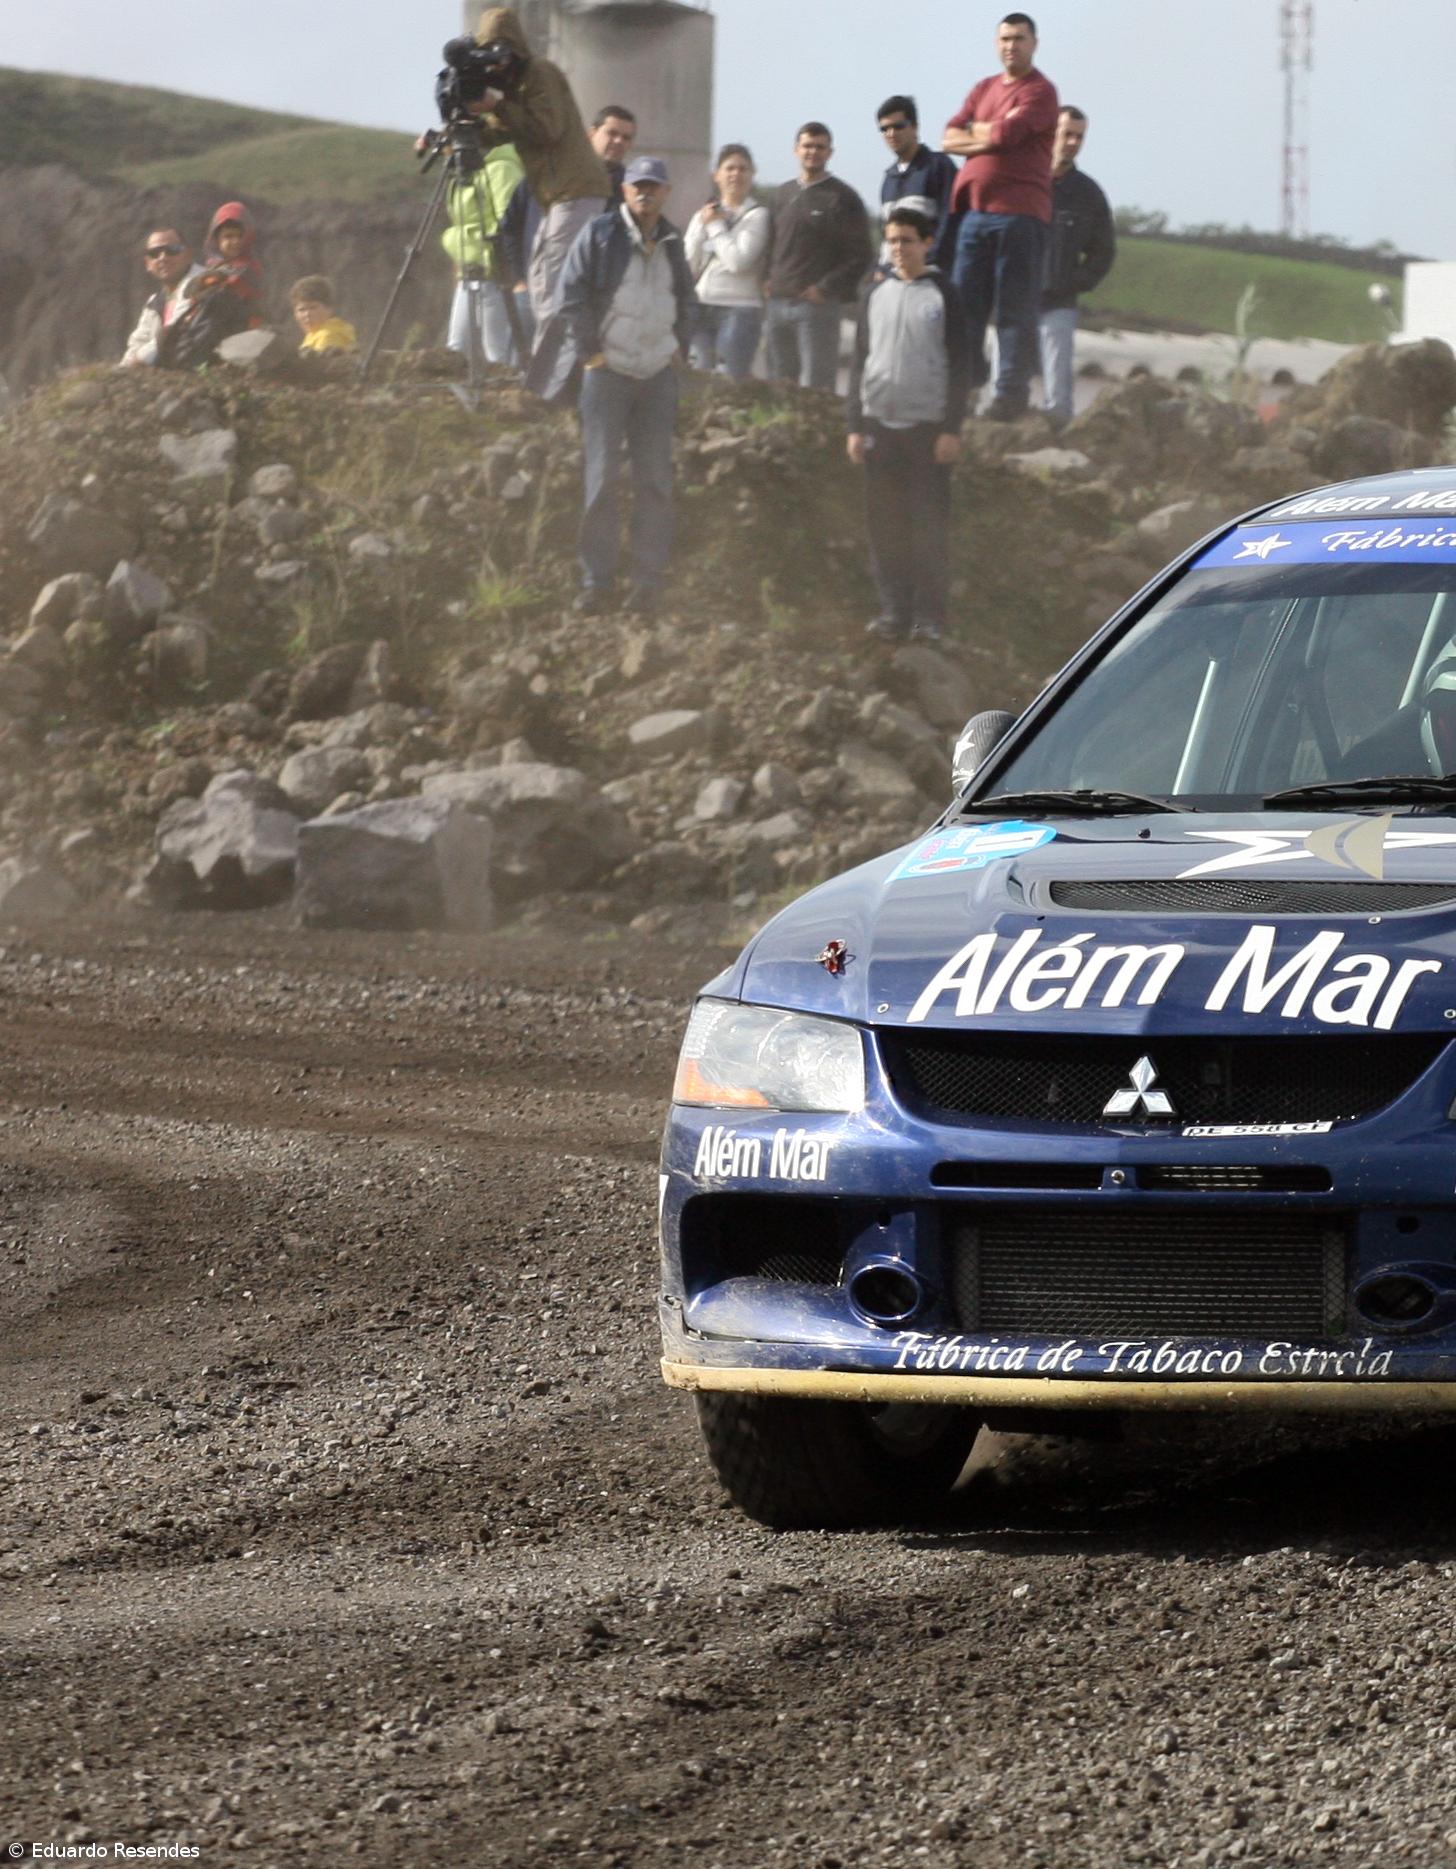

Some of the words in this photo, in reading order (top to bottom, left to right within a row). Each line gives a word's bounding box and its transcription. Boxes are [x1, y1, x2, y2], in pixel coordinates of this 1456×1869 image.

[906, 928, 1185, 1023] Além
[1204, 925, 1442, 1030] Mar
[694, 1126, 761, 1178] Além
[769, 1128, 836, 1181] Mar
[891, 1331, 1029, 1370] Fábrica
[1037, 1339, 1083, 1372] de
[1098, 1341, 1244, 1374] Tabaco
[1258, 1337, 1396, 1376] Estrela
